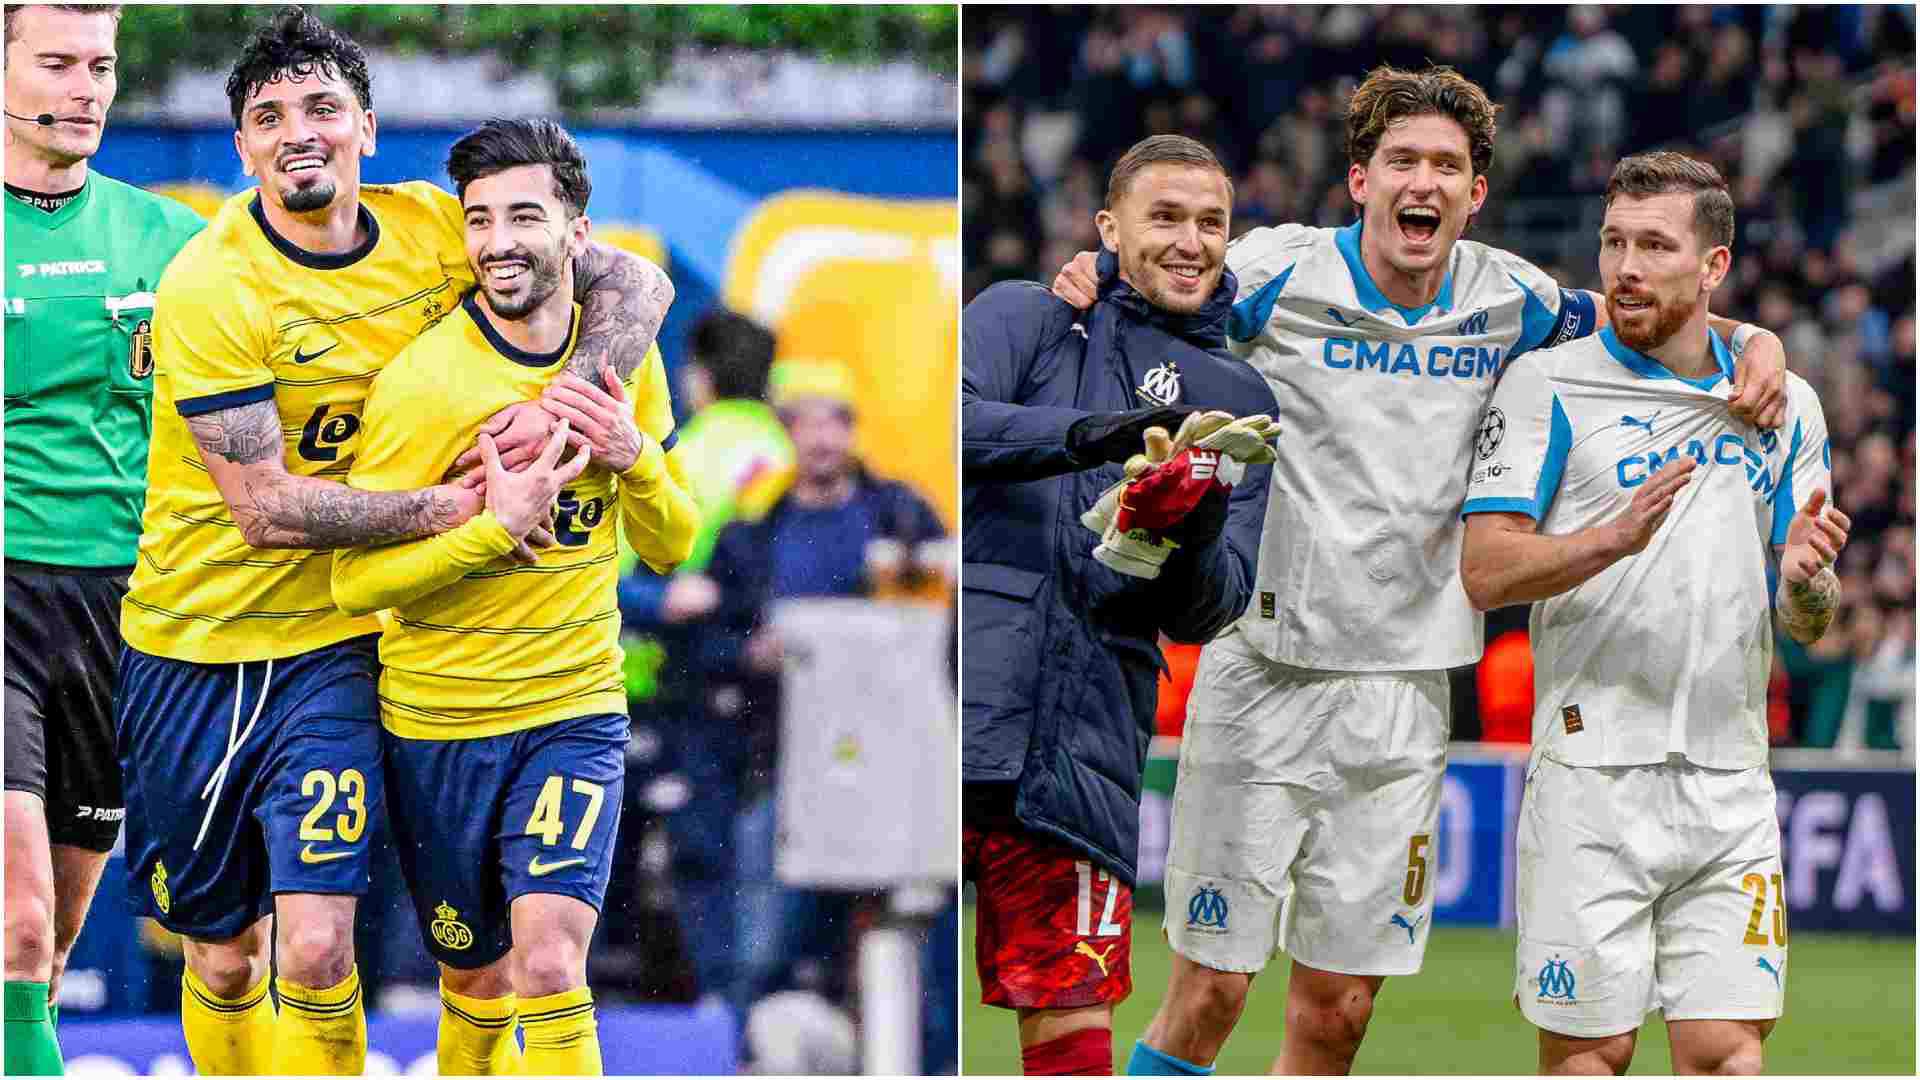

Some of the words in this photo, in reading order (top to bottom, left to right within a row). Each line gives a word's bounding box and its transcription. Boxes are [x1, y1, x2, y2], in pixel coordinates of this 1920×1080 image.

[38, 261, 107, 277] PATRICK
[1323, 338, 1411, 376] CMA
[1427, 345, 1501, 379] CGM
[299, 769, 367, 842] 23
[525, 775, 605, 850] 47
[1077, 861, 1122, 937] 12
[1403, 834, 1430, 906] 5
